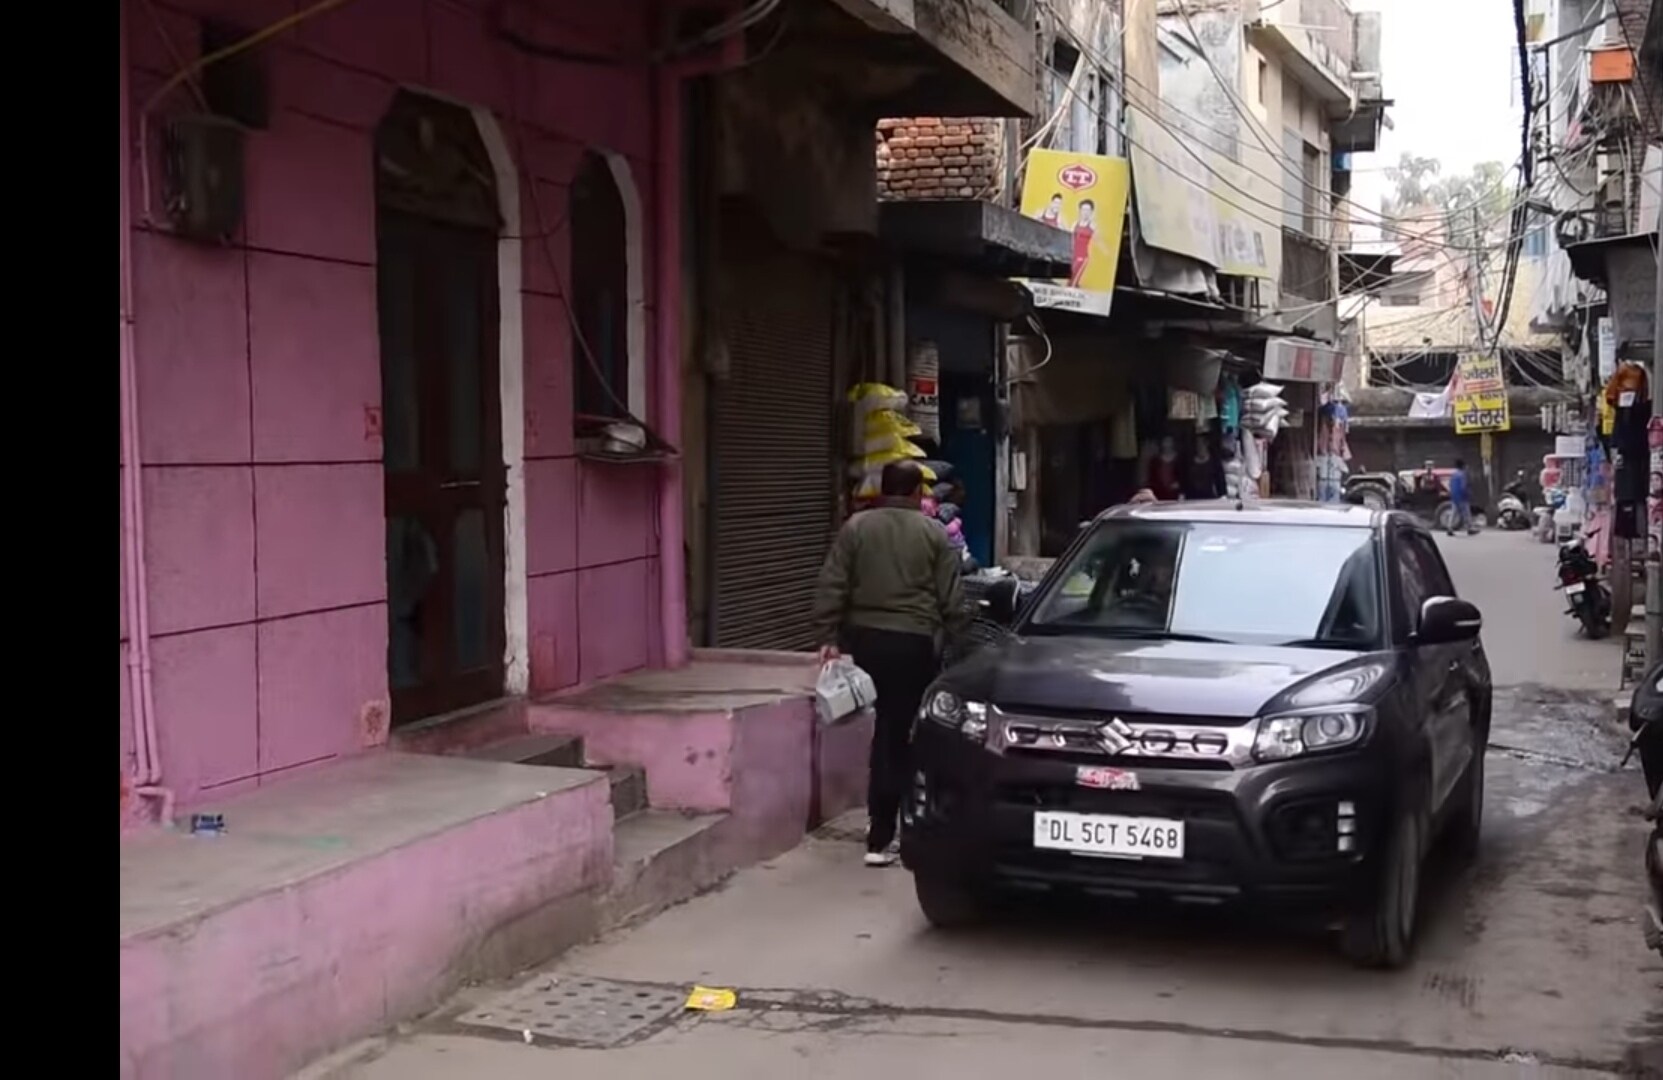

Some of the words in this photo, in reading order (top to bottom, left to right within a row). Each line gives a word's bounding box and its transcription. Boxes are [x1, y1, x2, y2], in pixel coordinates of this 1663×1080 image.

[1064, 170, 1090, 184] TT
[1050, 819, 1074, 843] DL
[1082, 822, 1118, 846] 5CT
[1127, 825, 1178, 850] 5468
